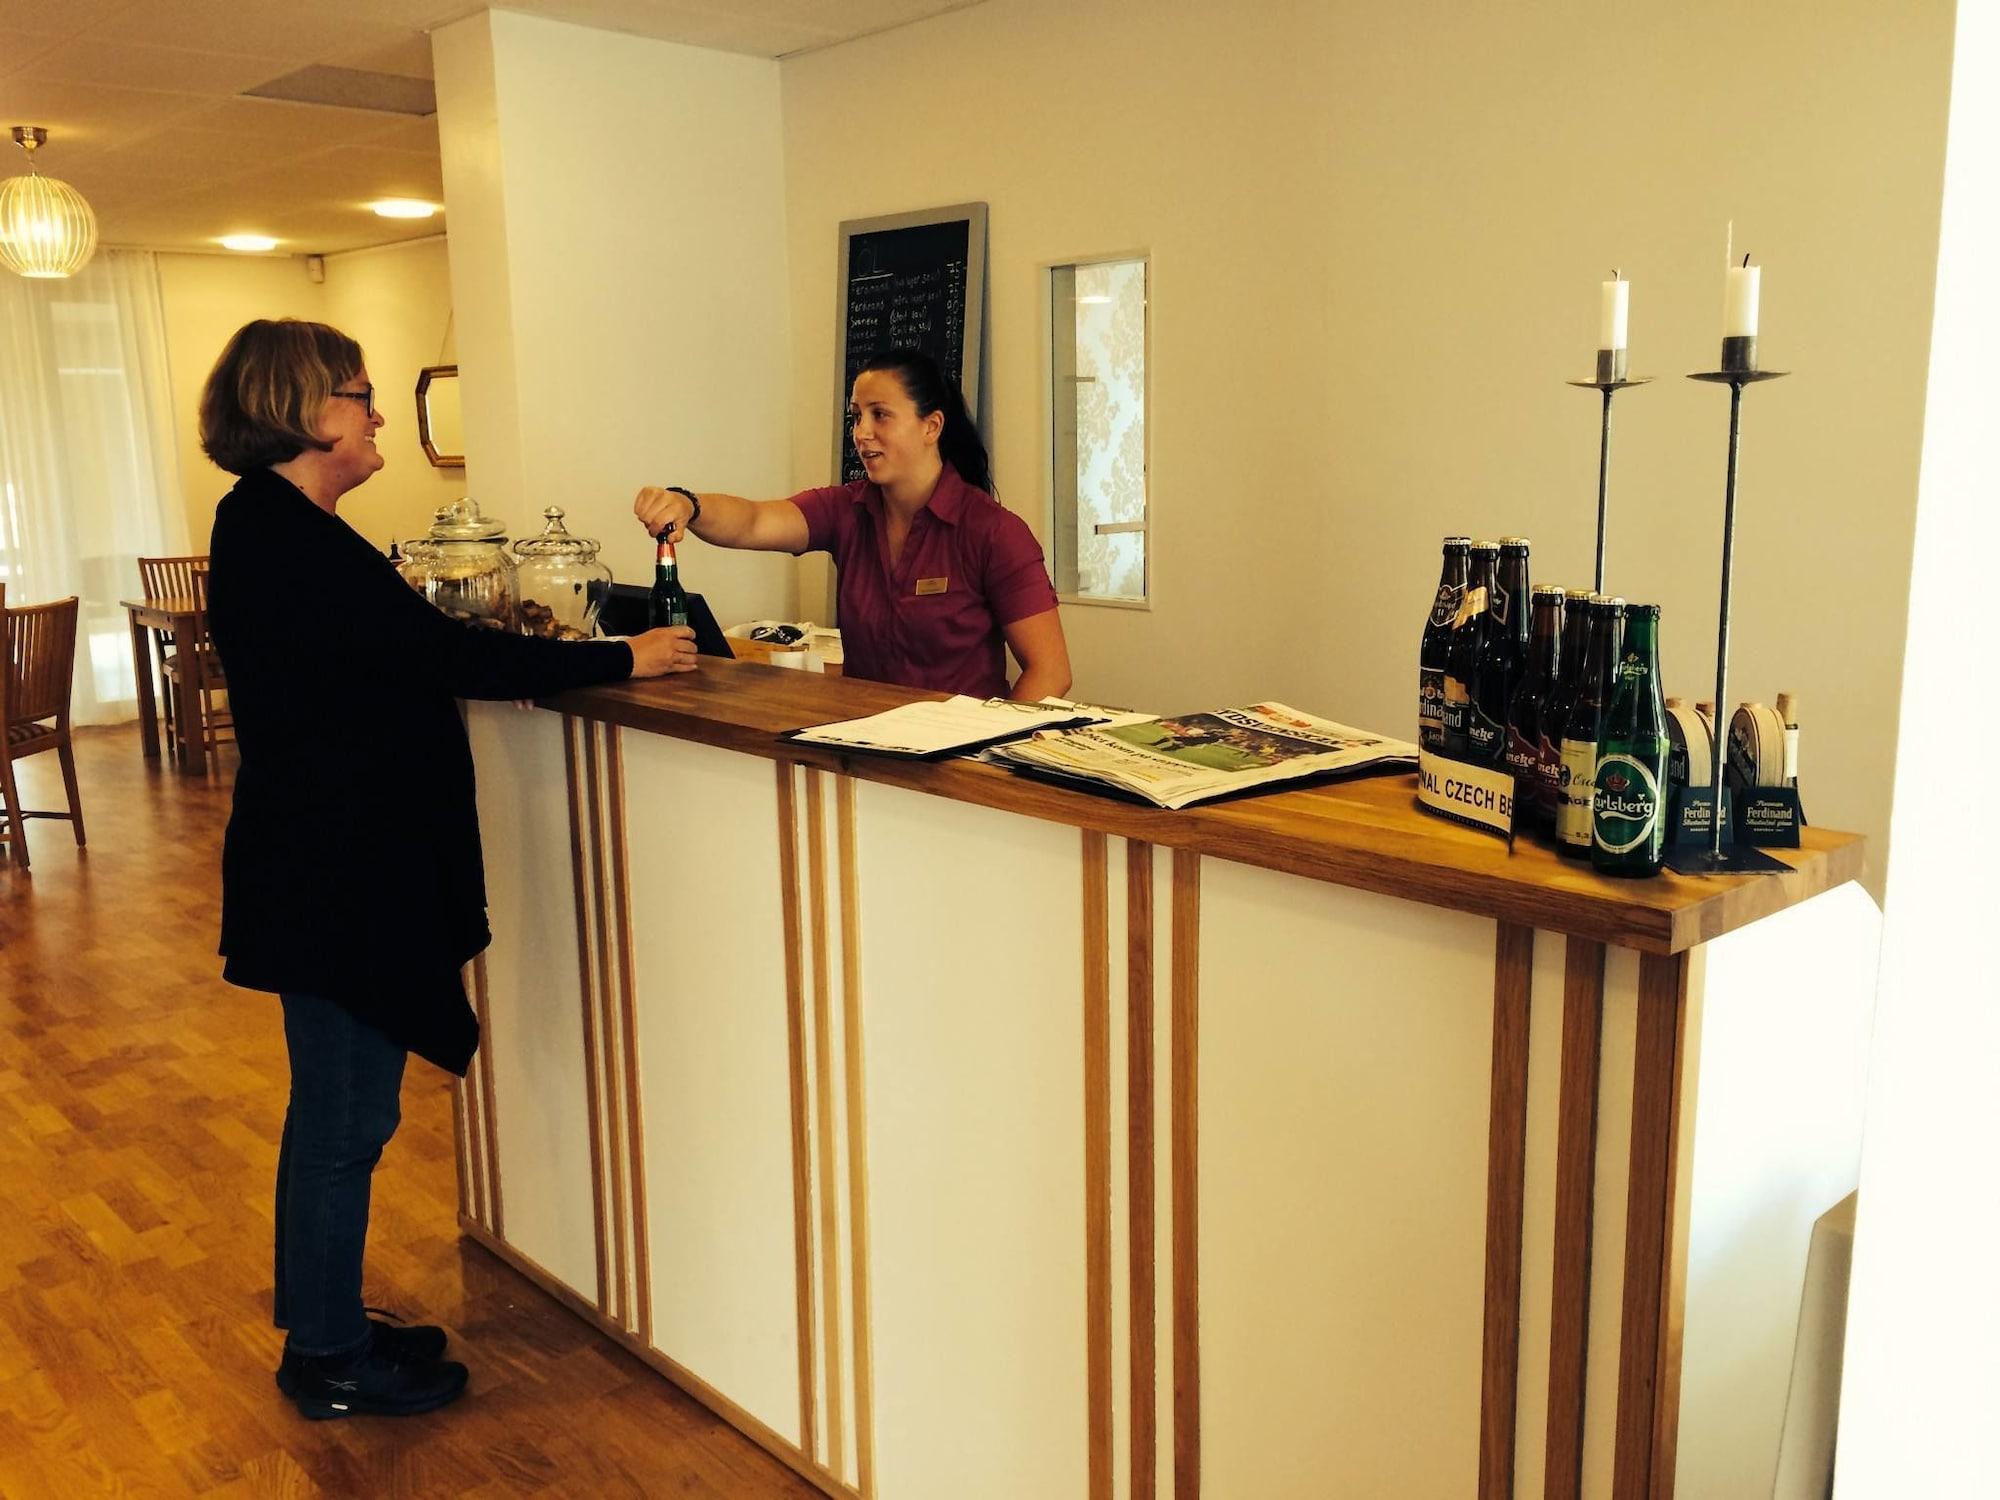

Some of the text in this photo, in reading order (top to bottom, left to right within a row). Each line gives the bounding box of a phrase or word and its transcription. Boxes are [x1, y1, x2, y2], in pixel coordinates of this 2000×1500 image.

[1445, 779, 1495, 811] CZECH
[1594, 788, 1654, 820] Carlsberg
[1747, 806, 1793, 820] Ferdinand
